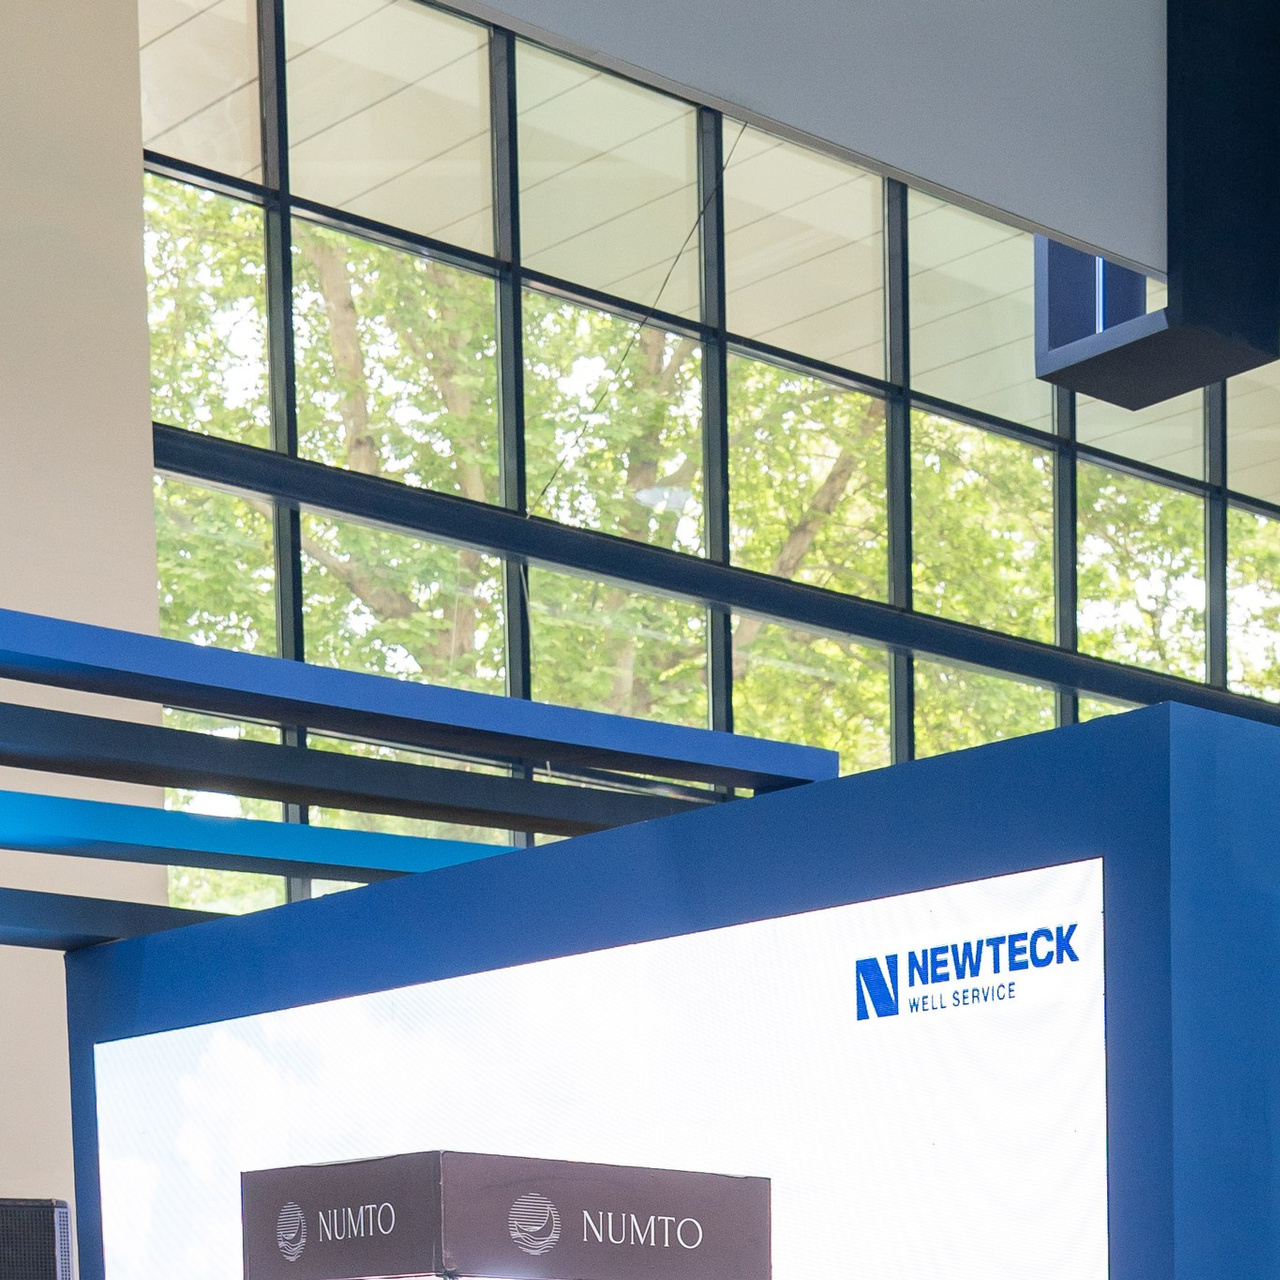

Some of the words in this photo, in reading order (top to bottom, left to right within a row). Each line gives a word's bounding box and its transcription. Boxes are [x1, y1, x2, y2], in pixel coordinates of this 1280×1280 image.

[907, 923, 1080, 988] NEWTECK
[908, 992, 947, 1013] WELL
[952, 981, 1016, 1008] SERVICE
[318, 1202, 396, 1243] NUMTO
[582, 1209, 704, 1250] NUMTO
